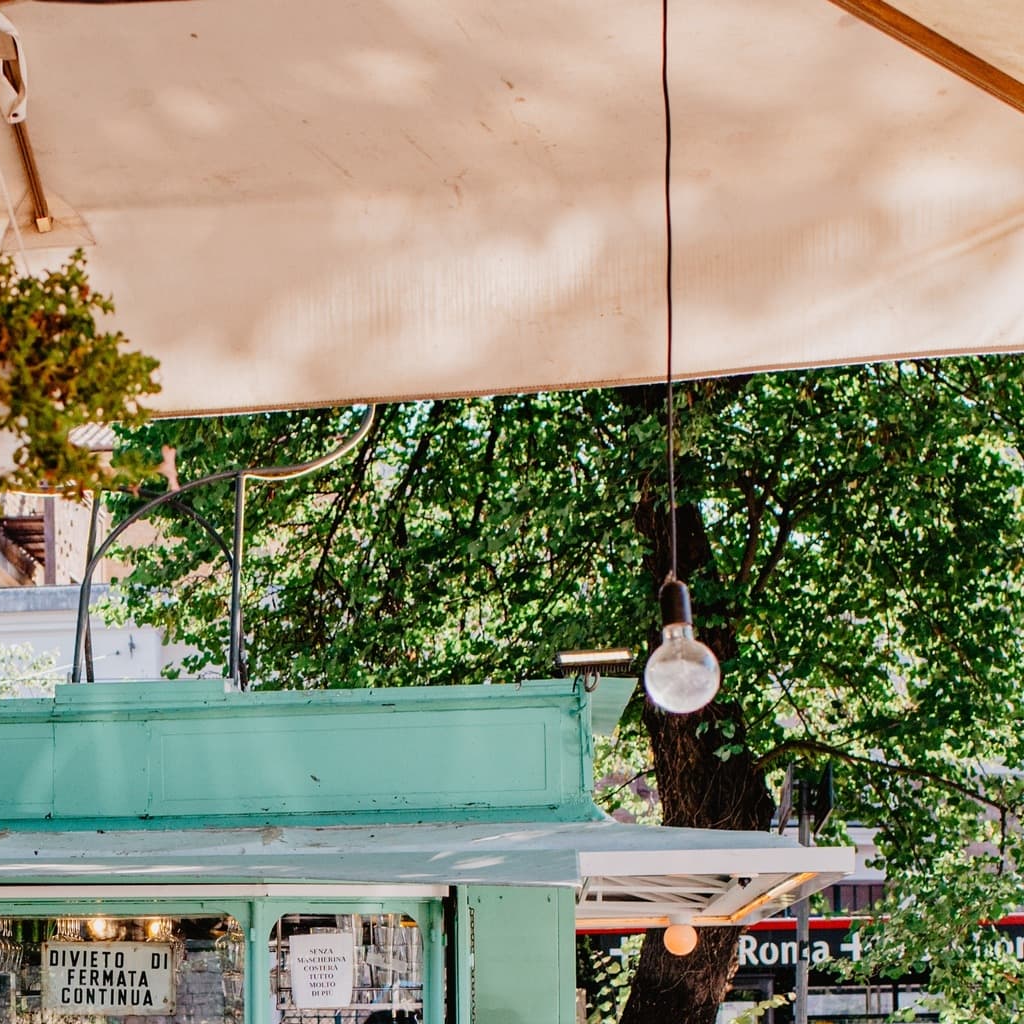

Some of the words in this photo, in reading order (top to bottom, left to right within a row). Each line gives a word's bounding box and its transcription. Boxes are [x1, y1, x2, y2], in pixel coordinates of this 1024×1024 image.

[49, 950, 124, 968] DIVIETO
[151, 953, 167, 969] DI
[67, 969, 149, 987] FERMATA
[61, 988, 153, 1006] CONTINUA
